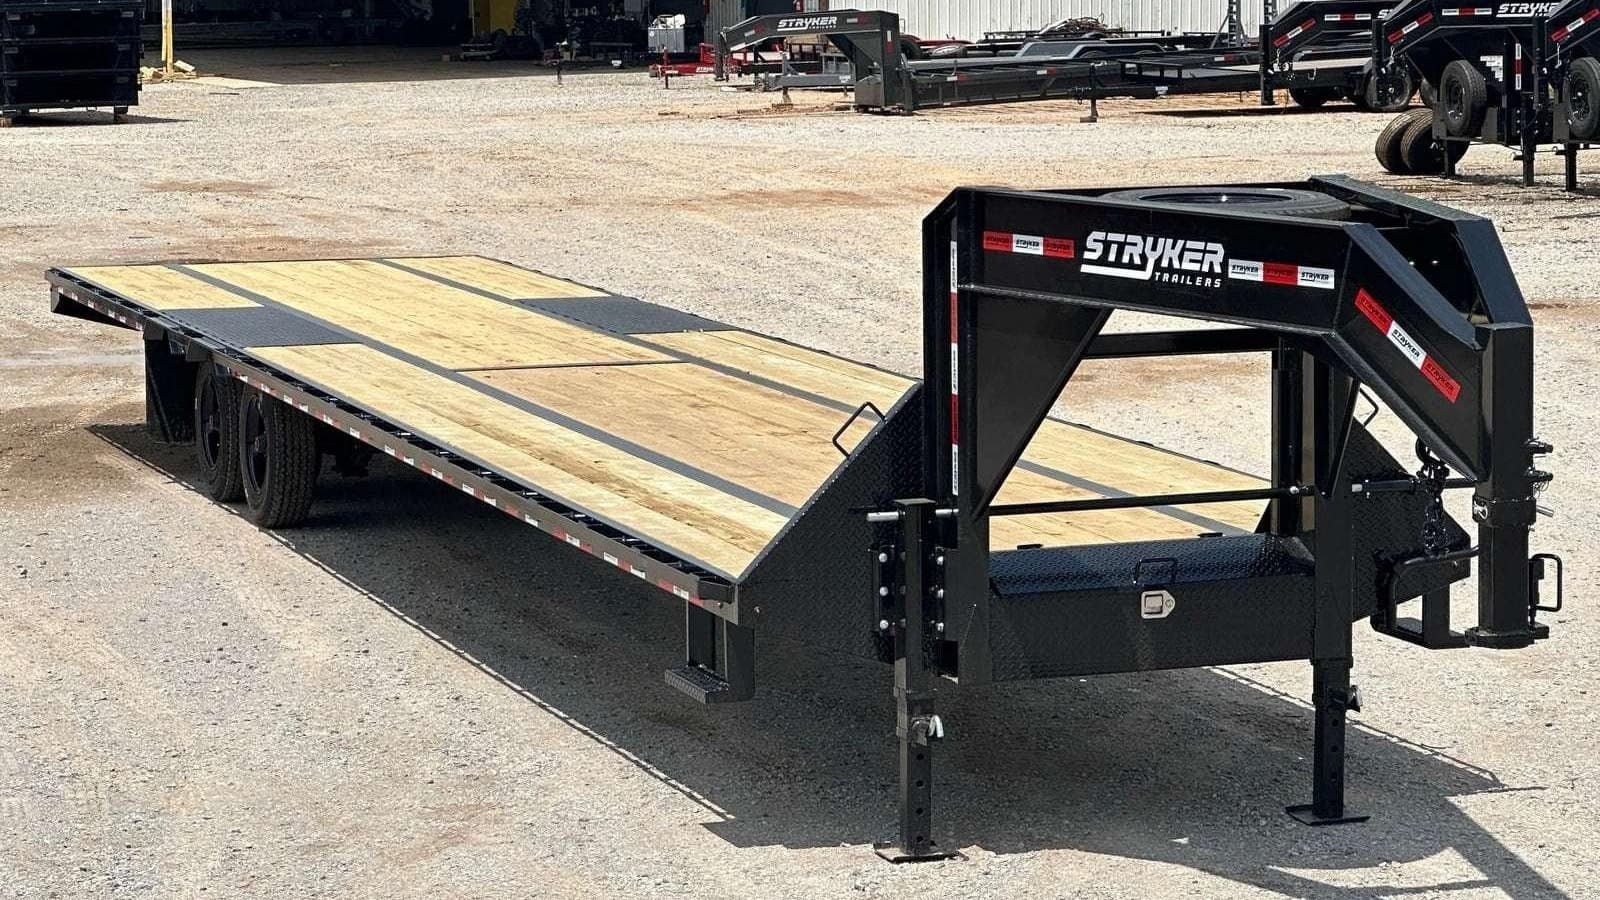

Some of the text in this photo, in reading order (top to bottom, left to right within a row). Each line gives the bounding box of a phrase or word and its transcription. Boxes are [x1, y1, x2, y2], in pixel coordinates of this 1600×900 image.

[1496, 2, 1560, 17] STRYKE
[777, 16, 837, 31] STRYKER
[1080, 231, 1225, 281] STRYKER
[1154, 271, 1222, 288] TRAILERS
[1391, 329, 1421, 359] STRYKER
